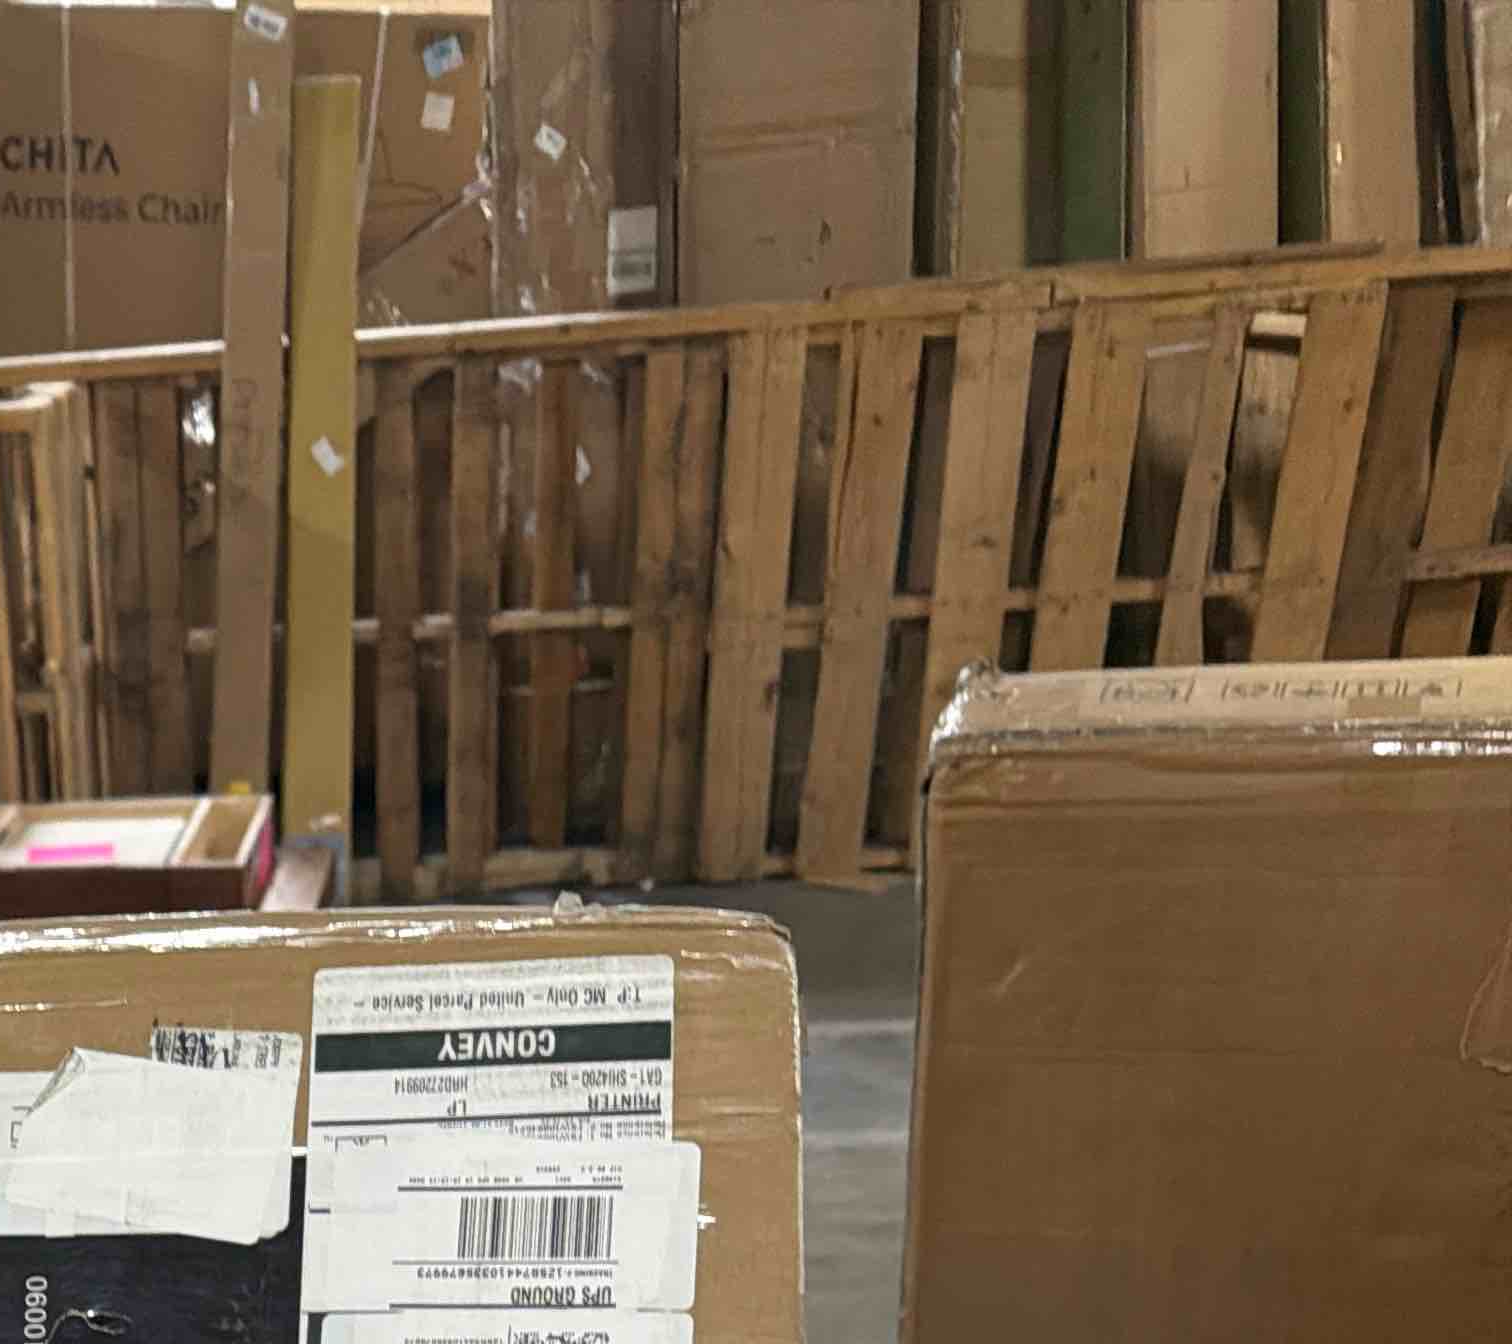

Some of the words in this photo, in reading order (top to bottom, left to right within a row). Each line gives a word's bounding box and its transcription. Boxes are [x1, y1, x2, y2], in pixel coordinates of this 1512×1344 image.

[1, 191, 129, 221] Armess
[437, 1028, 557, 1061] CONVEY
[587, 1093, 663, 1113] PRINTER
[510, 1285, 576, 1305] GROUND
[582, 1284, 613, 1305] UPS
